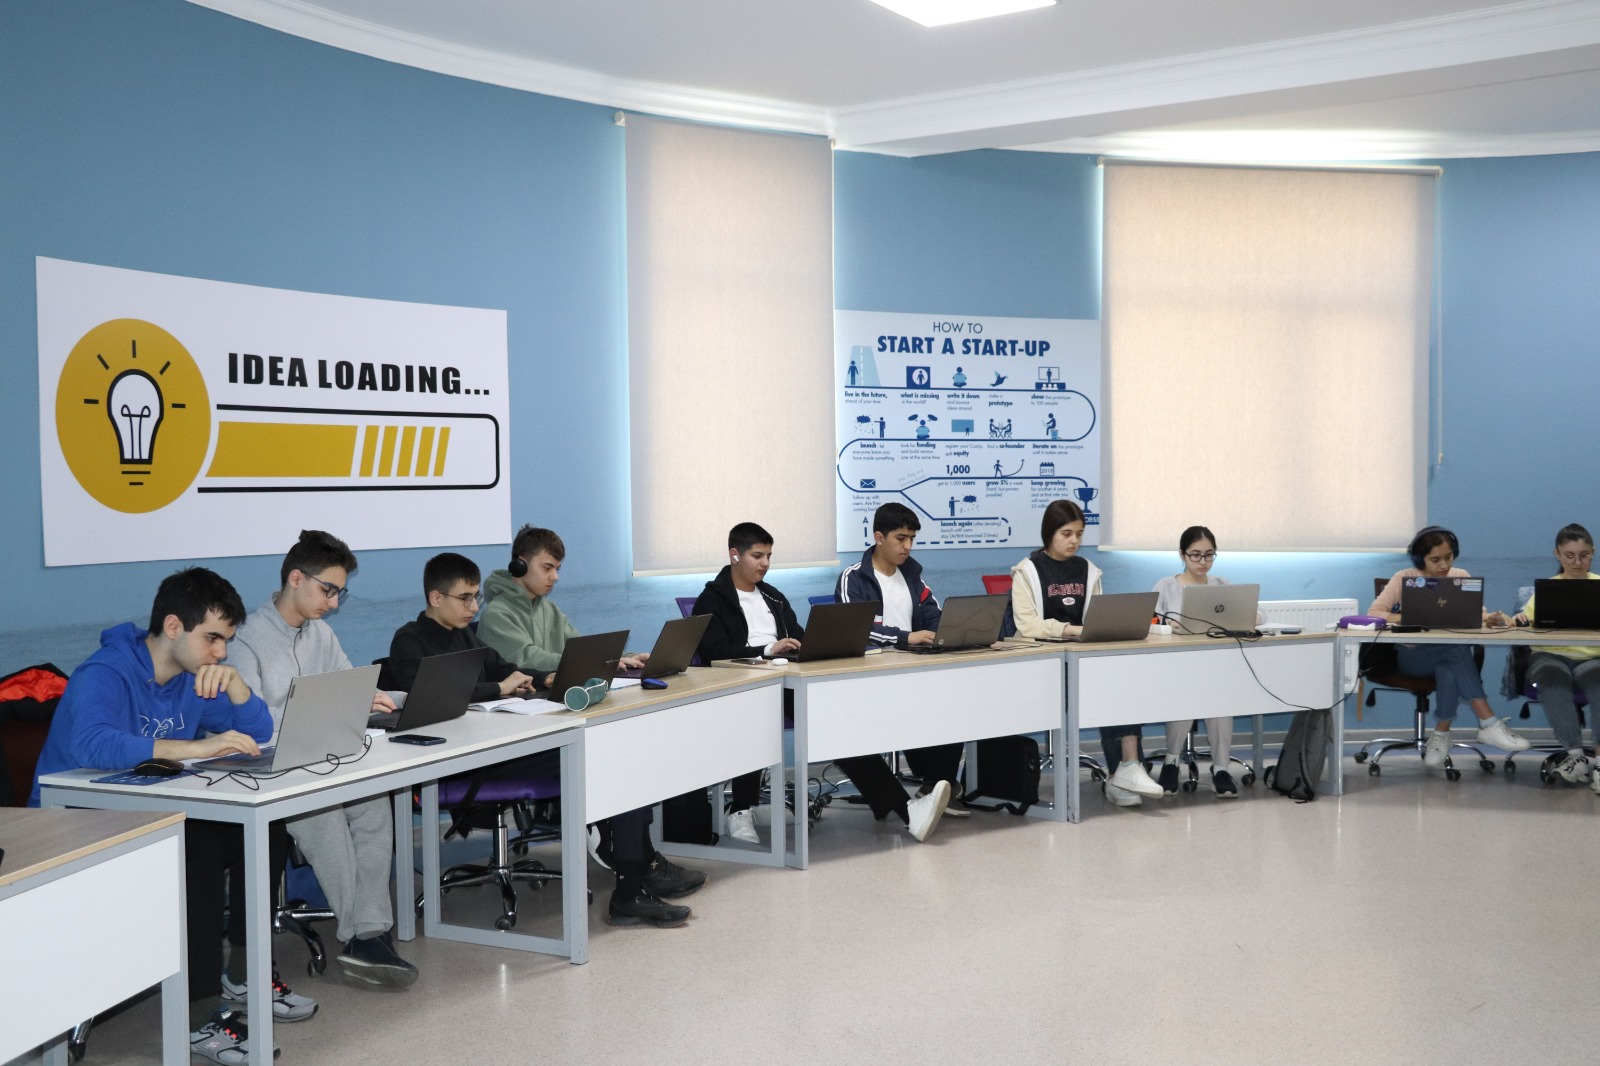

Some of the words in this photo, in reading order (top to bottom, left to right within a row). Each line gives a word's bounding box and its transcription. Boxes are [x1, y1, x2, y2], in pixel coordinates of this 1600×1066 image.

[933, 321, 964, 333] HOW
[967, 323, 984, 334] TO
[877, 335, 935, 354] START
[941, 337, 955, 355] A
[962, 338, 1051, 357] START-UP
[228, 352, 308, 388] IDEA
[318, 359, 490, 396] LOADING...
[870, 390, 888, 399] future,
[920, 392, 940, 400] missing
[946, 464, 970, 476] 1,000
